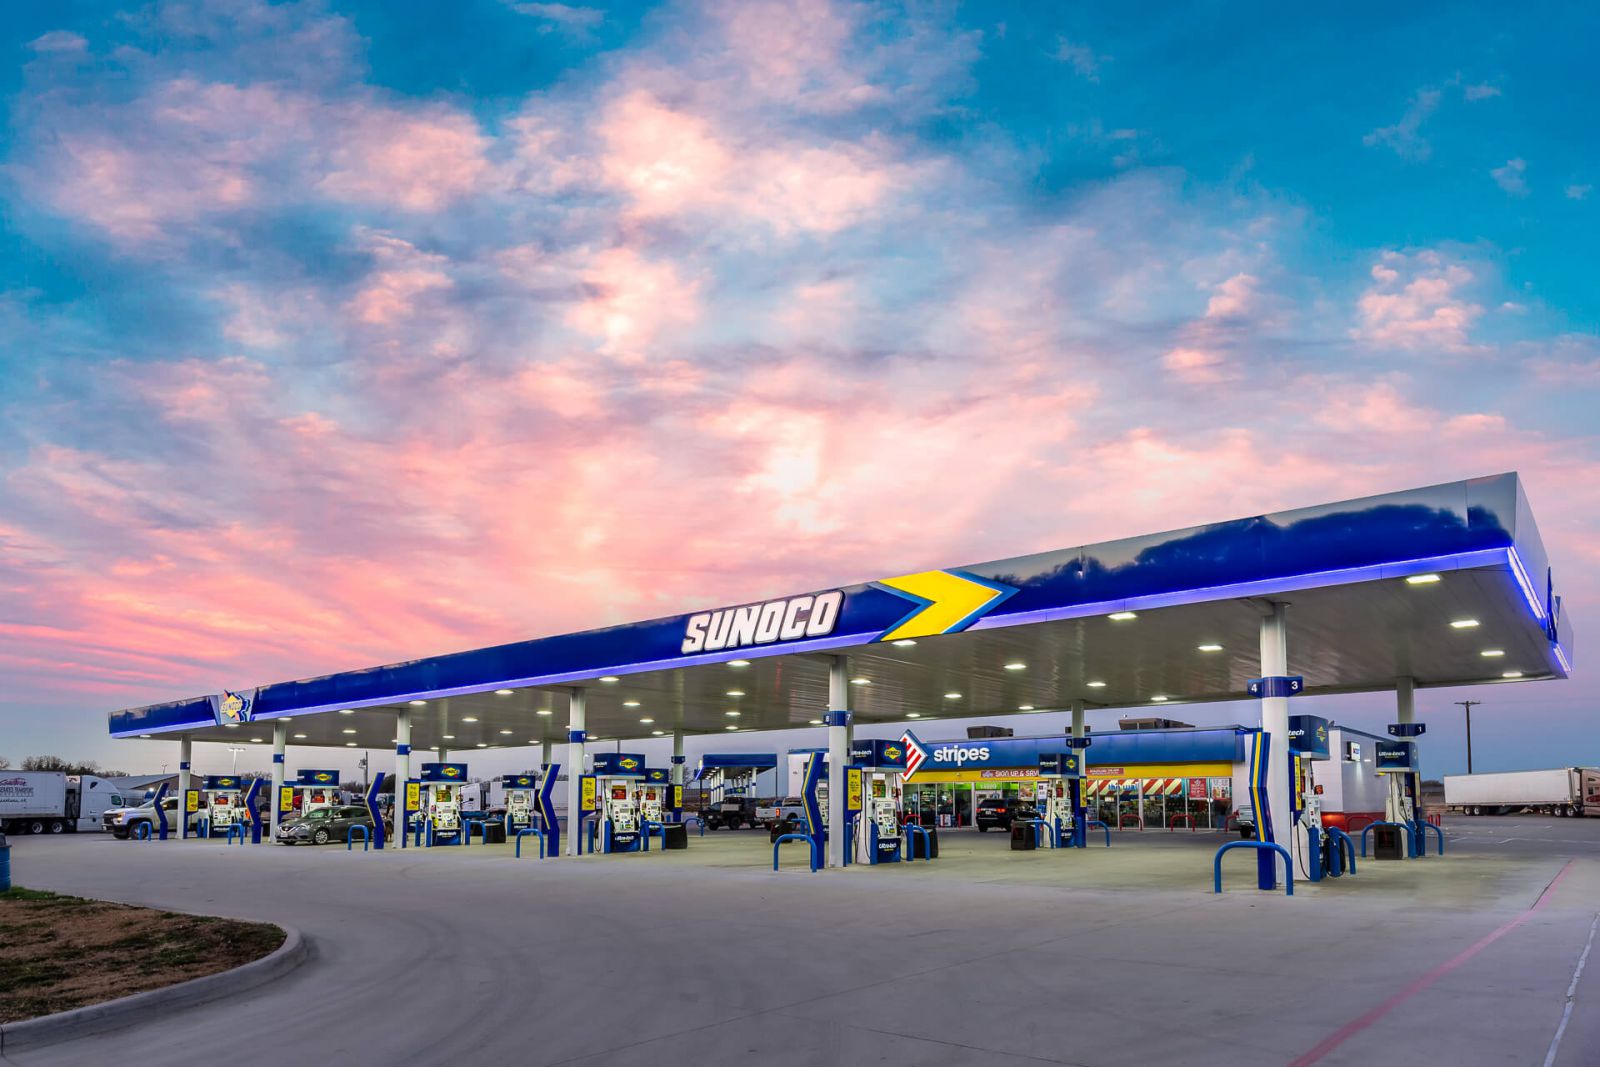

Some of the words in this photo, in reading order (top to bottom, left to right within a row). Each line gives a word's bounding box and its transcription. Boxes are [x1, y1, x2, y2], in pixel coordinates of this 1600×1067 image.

[681, 590, 842, 654] SUNOCO
[1251, 683, 1258, 692] 4
[1291, 681, 1298, 690] 3
[933, 744, 990, 766] stripes
